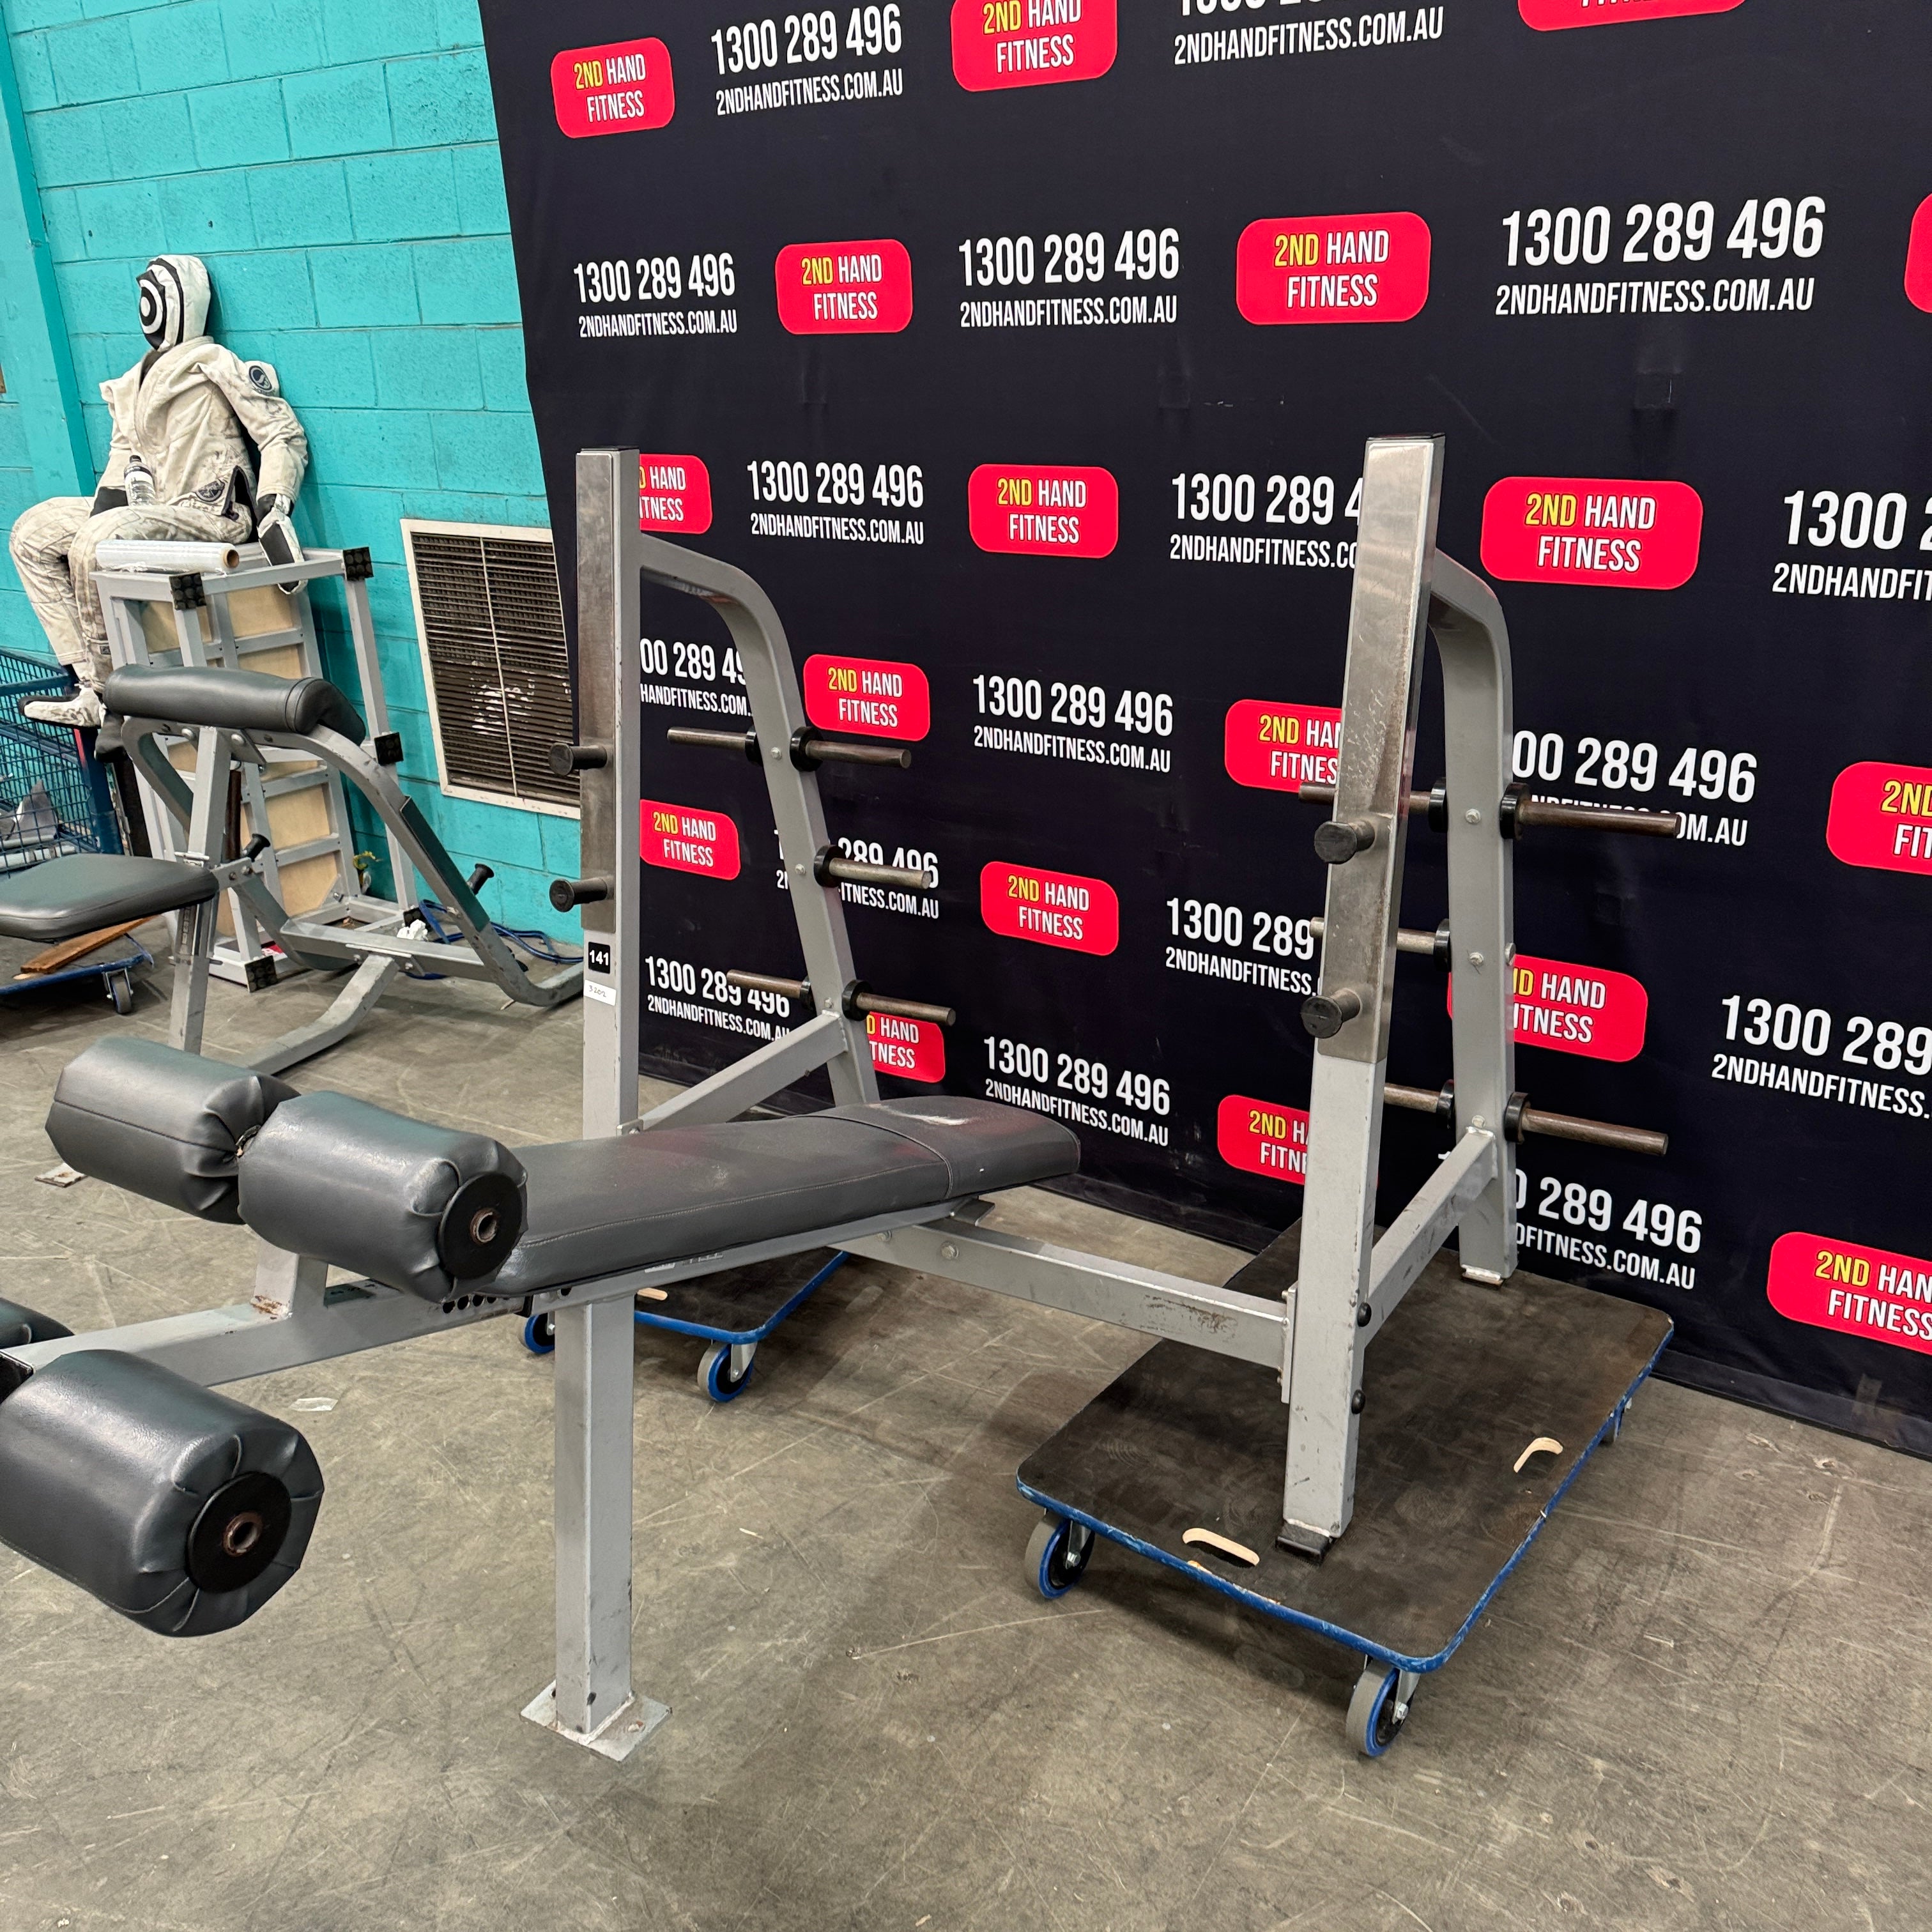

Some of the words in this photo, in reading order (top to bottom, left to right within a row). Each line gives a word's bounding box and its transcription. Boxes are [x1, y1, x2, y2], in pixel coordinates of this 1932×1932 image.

[983, 0, 1022, 34] 2ND
[1028, 0, 1082, 28] HAND
[711, 19, 778, 75] 1300
[785, 11, 837, 63] 289
[846, 4, 901, 56] 496
[997, 34, 1073, 72] FITNESS
[1174, 6, 1444, 65] 2NDHANDFITNESS.COM.AU
[574, 61, 602, 89] 2ND
[606, 54, 645, 84] HAND
[587, 90, 644, 122] FITNESS
[716, 68, 902, 115] 2NDHANDFITNESS.COM.AU
[1275, 234, 1318, 266] 2ND
[1327, 231, 1388, 264] HAND
[1503, 206, 1610, 266] 1300
[1623, 201, 1714, 262] 289
[1727, 196, 1825, 258] 496
[802, 257, 832, 284] 2ND
[838, 255, 882, 282] HAND
[959, 236, 1034, 286] 1300
[1045, 232, 1104, 283] 289
[1115, 228, 1179, 280] 496
[574, 260, 631, 302] 1300
[636, 257, 681, 300] 289
[689, 253, 735, 296] 496
[1288, 274, 1377, 307] FITNESS
[814, 292, 877, 319] FITNESS
[960, 295, 1176, 327] 2NDHANDFITNESS.COM.AU
[1496, 278, 1814, 315] 2NDHANDFITNESS.COM.AU
[579, 309, 737, 337] 2NDHANDFITNESS.COM.AU
[649, 466, 686, 491] HAND
[747, 461, 808, 502] 1300
[816, 463, 864, 505] 289
[873, 464, 923, 508] 496
[998, 479, 1031, 505] 2ND
[1039, 480, 1085, 507] HAND
[1172, 473, 1255, 522] 1300
[1266, 475, 1334, 525] 289
[1526, 494, 1576, 526] 2ND
[1585, 496, 1655, 528] HAND
[751, 513, 923, 544] 2NDHANDFITNESS.COM.AU
[1010, 514, 1078, 543] FITNESS
[1784, 490, 1907, 550] 1300
[1538, 536, 1641, 571] FITNESS
[673, 642, 716, 680] 289
[829, 668, 857, 692] 2ND
[862, 671, 902, 697] HAND
[839, 698, 898, 727] FITNESS
[973, 675, 1041, 719] 1300
[1051, 682, 1105, 728] 289
[1115, 691, 1172, 736] 496
[1260, 715, 1299, 744] 2ND
[974, 726, 1170, 772] 2NDHANDFITNESS.COM.AU
[1575, 737, 1657, 792] 289
[1669, 748, 1756, 802] 496
[654, 812, 678, 834] 2ND
[682, 816, 716, 841] HAND
[664, 839, 713, 866] FITNESS
[1009, 875, 1039, 901] 2ND
[1045, 882, 1089, 910] HAND
[1020, 906, 1082, 939] FITNESS
[1167, 898, 1242, 946] 1300
[1252, 911, 1314, 960] 289
[589, 949, 610, 966] 141
[645, 956, 696, 995] 1300
[701, 968, 742, 1006] 289
[1542, 973, 1605, 1008] HAND
[881, 1017, 919, 1043] HAND
[1722, 995, 1830, 1055] 1300
[1843, 1016, 1932, 1076] 289
[985, 1036, 1048, 1082] 1300
[1057, 1054, 1107, 1098] 289
[1116, 1071, 1169, 1115] 496
[986, 1078, 1168, 1146] 2NDHANDFITNESS.COM.AU
[1250, 1110, 1285, 1138] 2ND
[1538, 1177, 1612, 1231] 289
[1623, 1199, 1702, 1253] 496
[1816, 1252, 1869, 1286] 2ND
